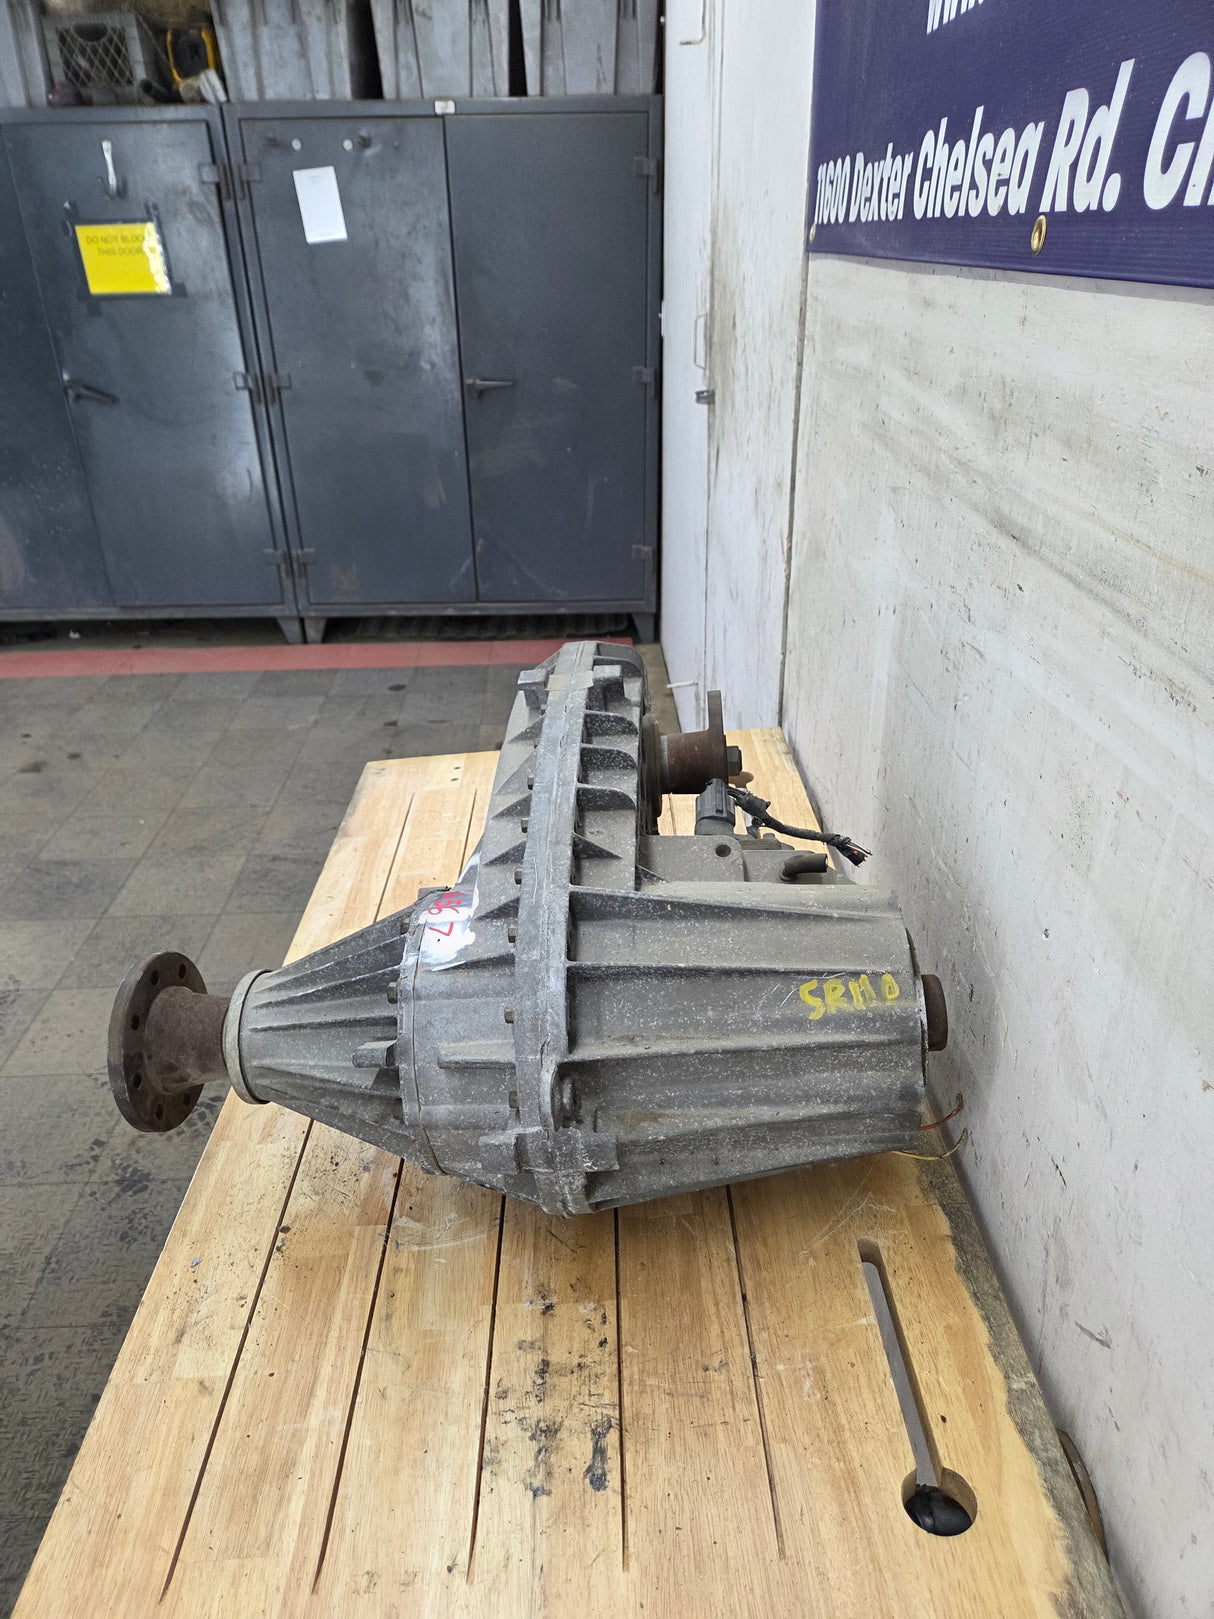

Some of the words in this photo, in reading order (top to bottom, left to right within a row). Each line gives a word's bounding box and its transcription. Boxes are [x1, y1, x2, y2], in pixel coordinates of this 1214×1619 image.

[815, 154, 851, 224] 11600
[849, 142, 914, 222] Dexter
[913, 105, 1045, 219] Chelsea
[1039, 58, 1135, 213] Rd.
